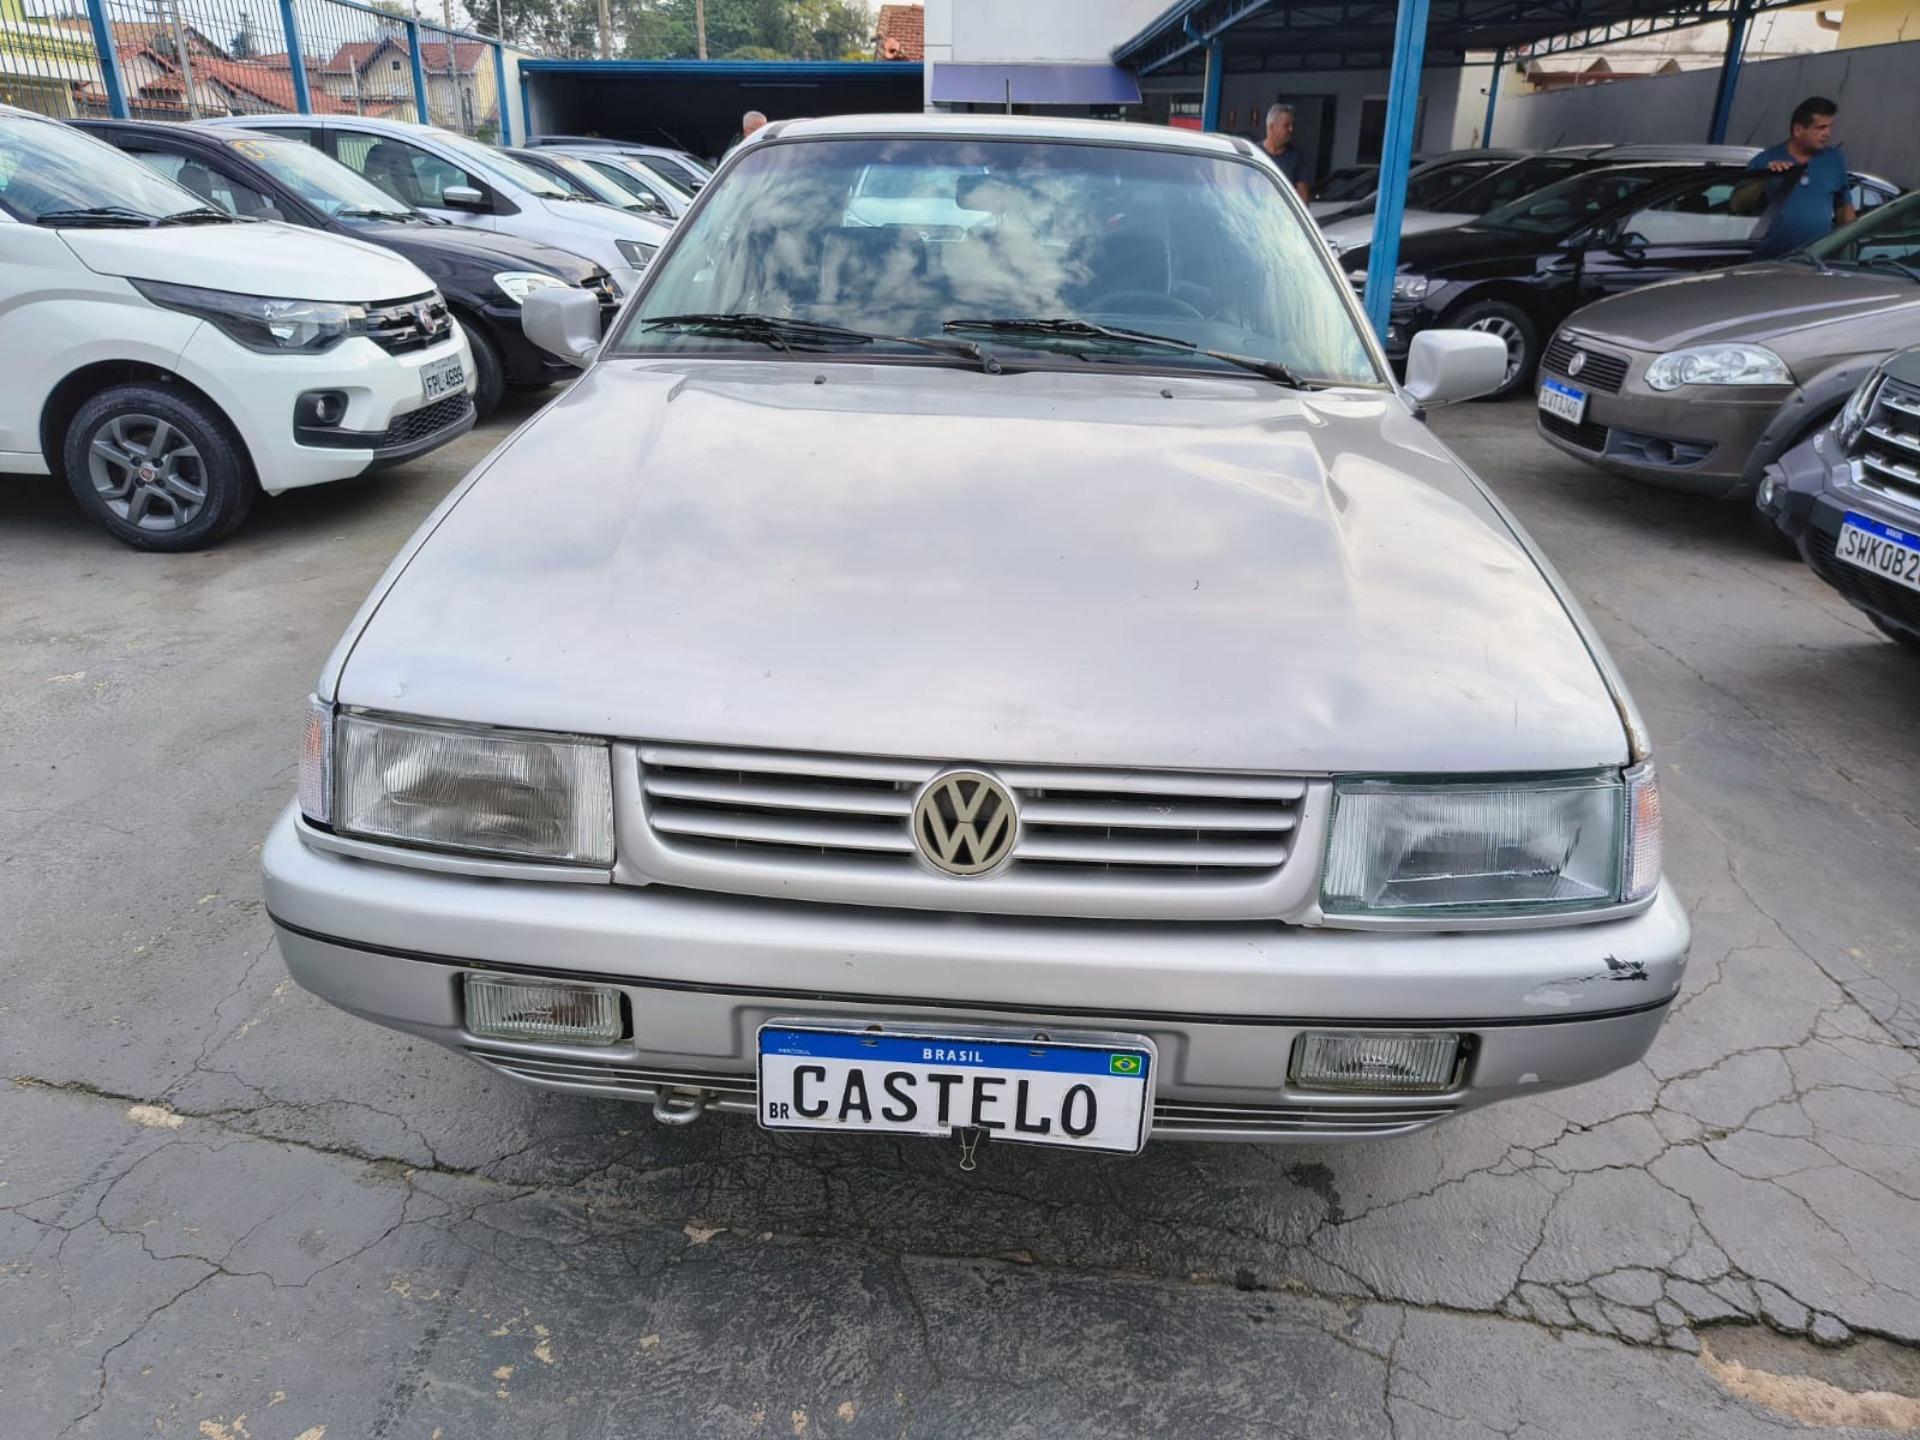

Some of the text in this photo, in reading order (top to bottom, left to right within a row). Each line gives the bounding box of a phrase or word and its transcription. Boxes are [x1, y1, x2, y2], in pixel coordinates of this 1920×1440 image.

[1845, 530, 1920, 583] SWK0B2
[922, 1047, 984, 1064] BRASIL
[769, 1102, 789, 1120] BR
[793, 1065, 1097, 1138] CASTELO
